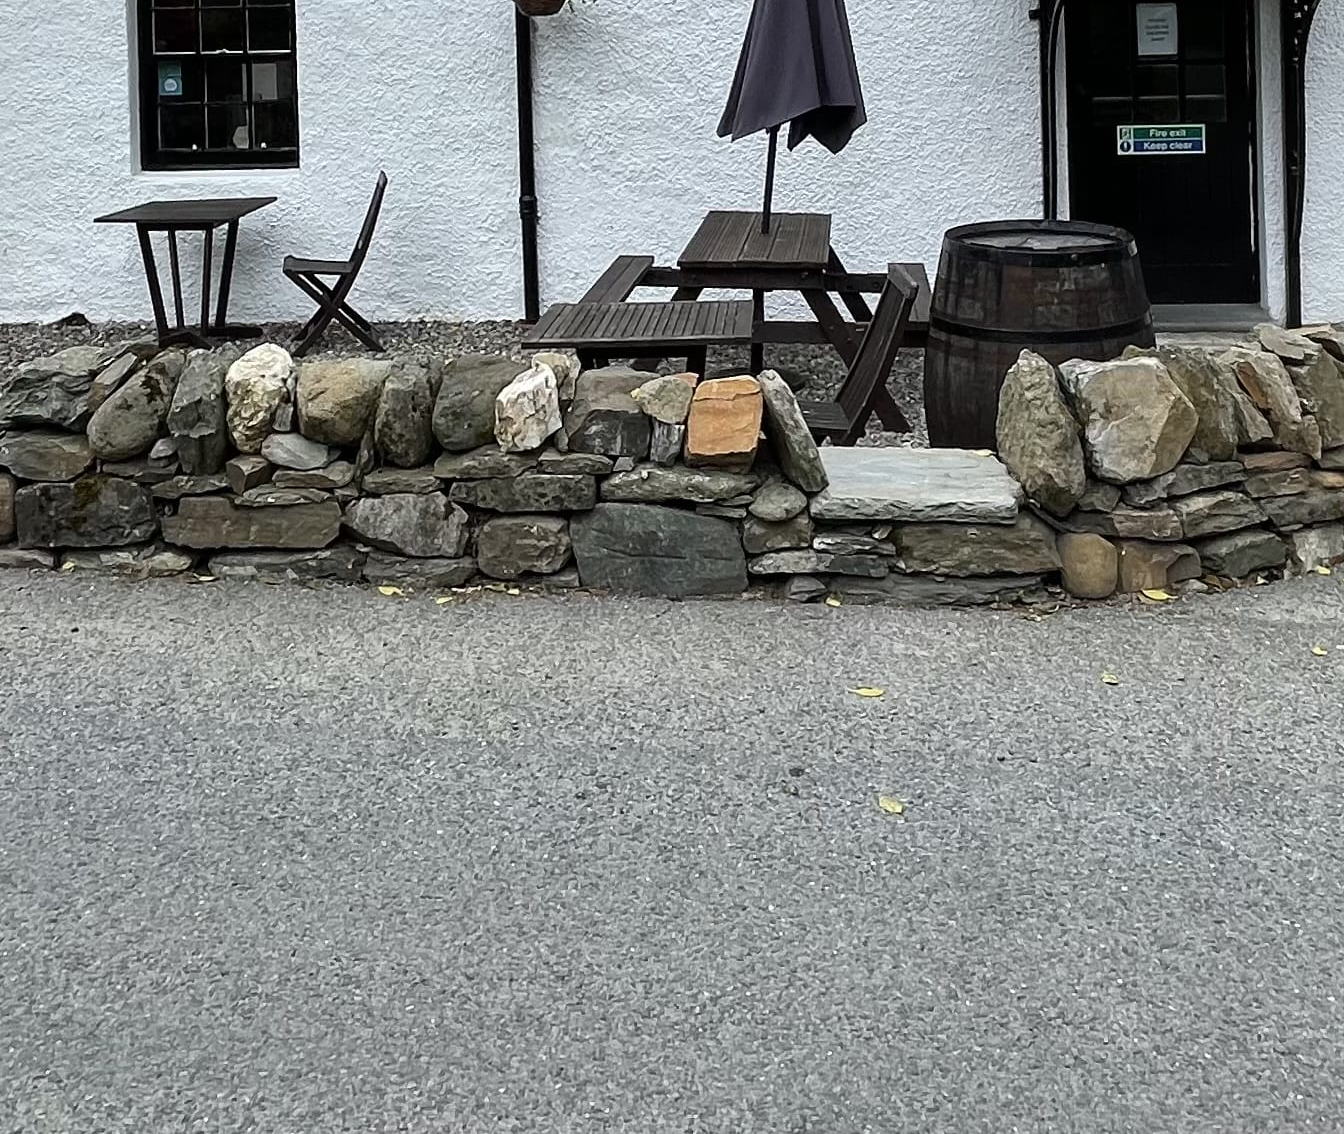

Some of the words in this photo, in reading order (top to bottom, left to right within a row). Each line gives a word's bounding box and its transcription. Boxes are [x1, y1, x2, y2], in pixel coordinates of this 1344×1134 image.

[1149, 128, 1168, 138] Fire
[1169, 129, 1187, 138] exit
[1143, 141, 1168, 151] Keep
[1169, 141, 1193, 150] clear
